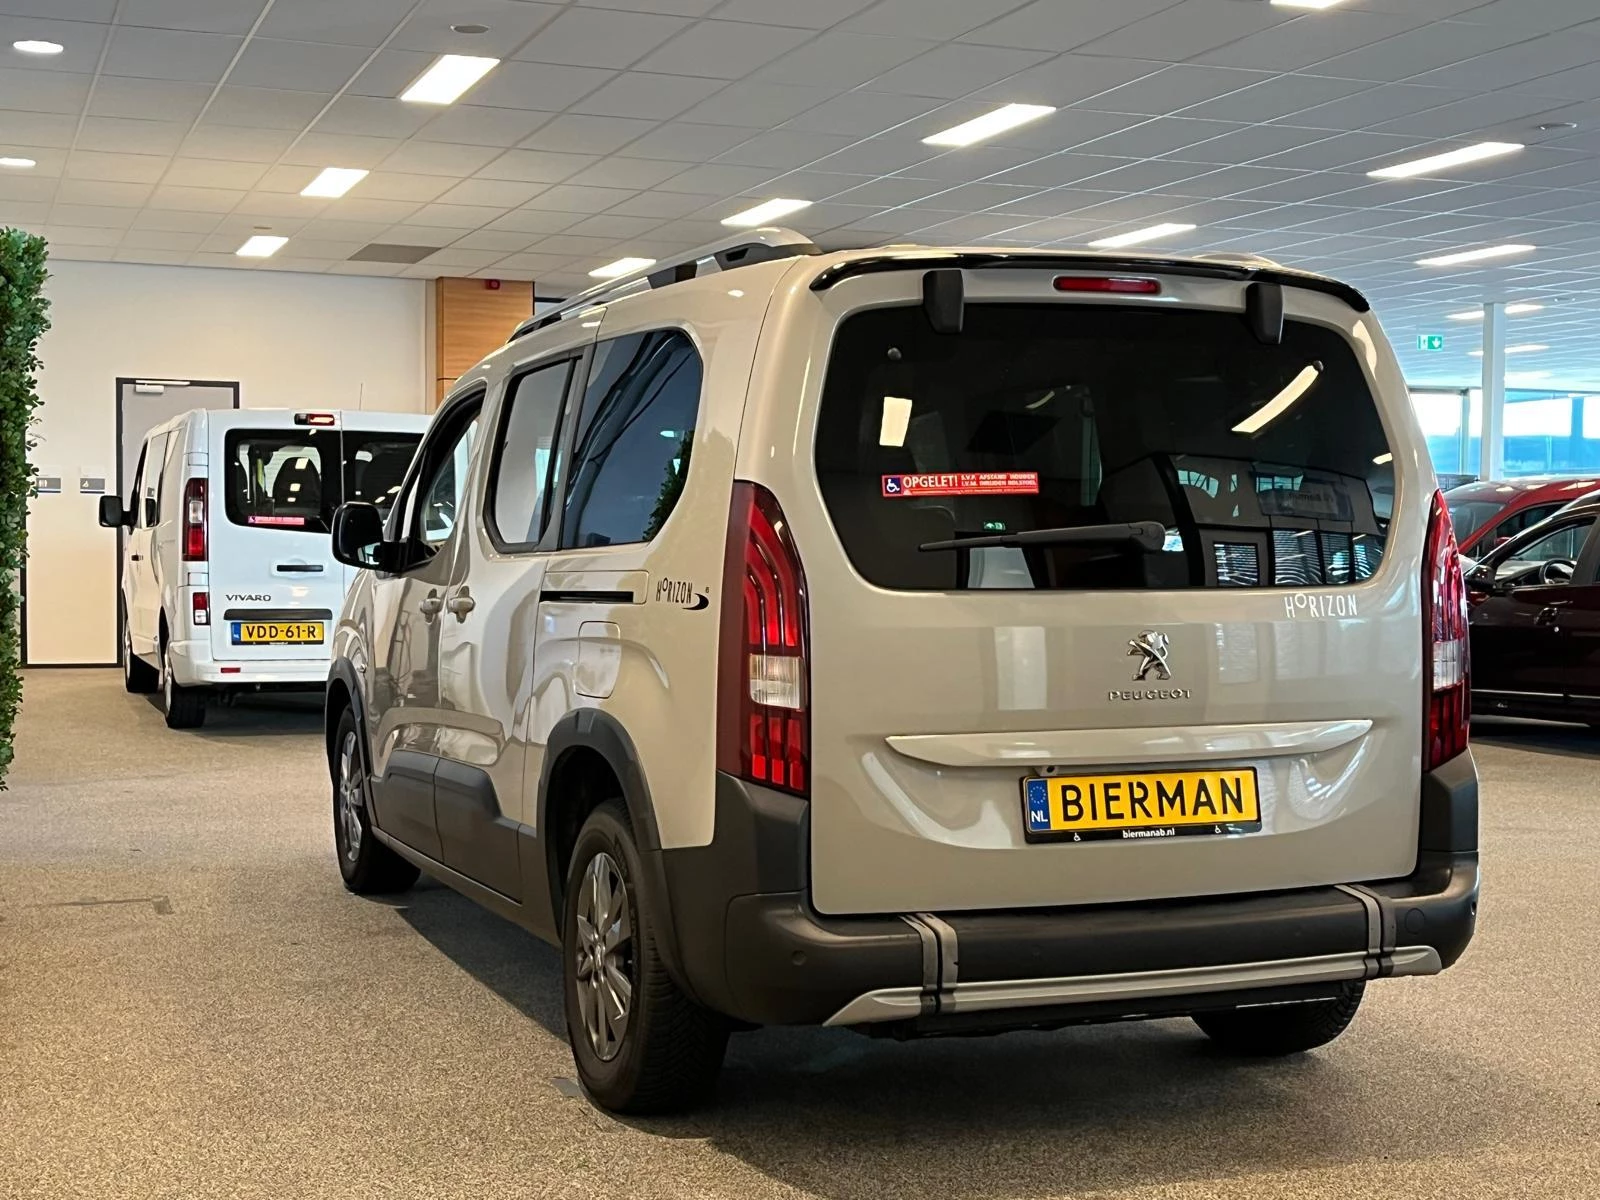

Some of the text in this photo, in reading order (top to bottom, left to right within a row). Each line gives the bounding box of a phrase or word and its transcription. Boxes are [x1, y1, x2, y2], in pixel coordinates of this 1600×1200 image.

[903, 475, 958, 489] OPGELET!
[656, 577, 693, 604] HORIZON
[225, 594, 272, 602] VIVARO
[1284, 592, 1358, 618] HORIZON
[246, 625, 316, 639] VDD-61-R
[1108, 688, 1192, 701] PEUGEOT
[1031, 777, 1244, 823] NL BIERMAN
[1122, 828, 1175, 839] biermanab.nl
